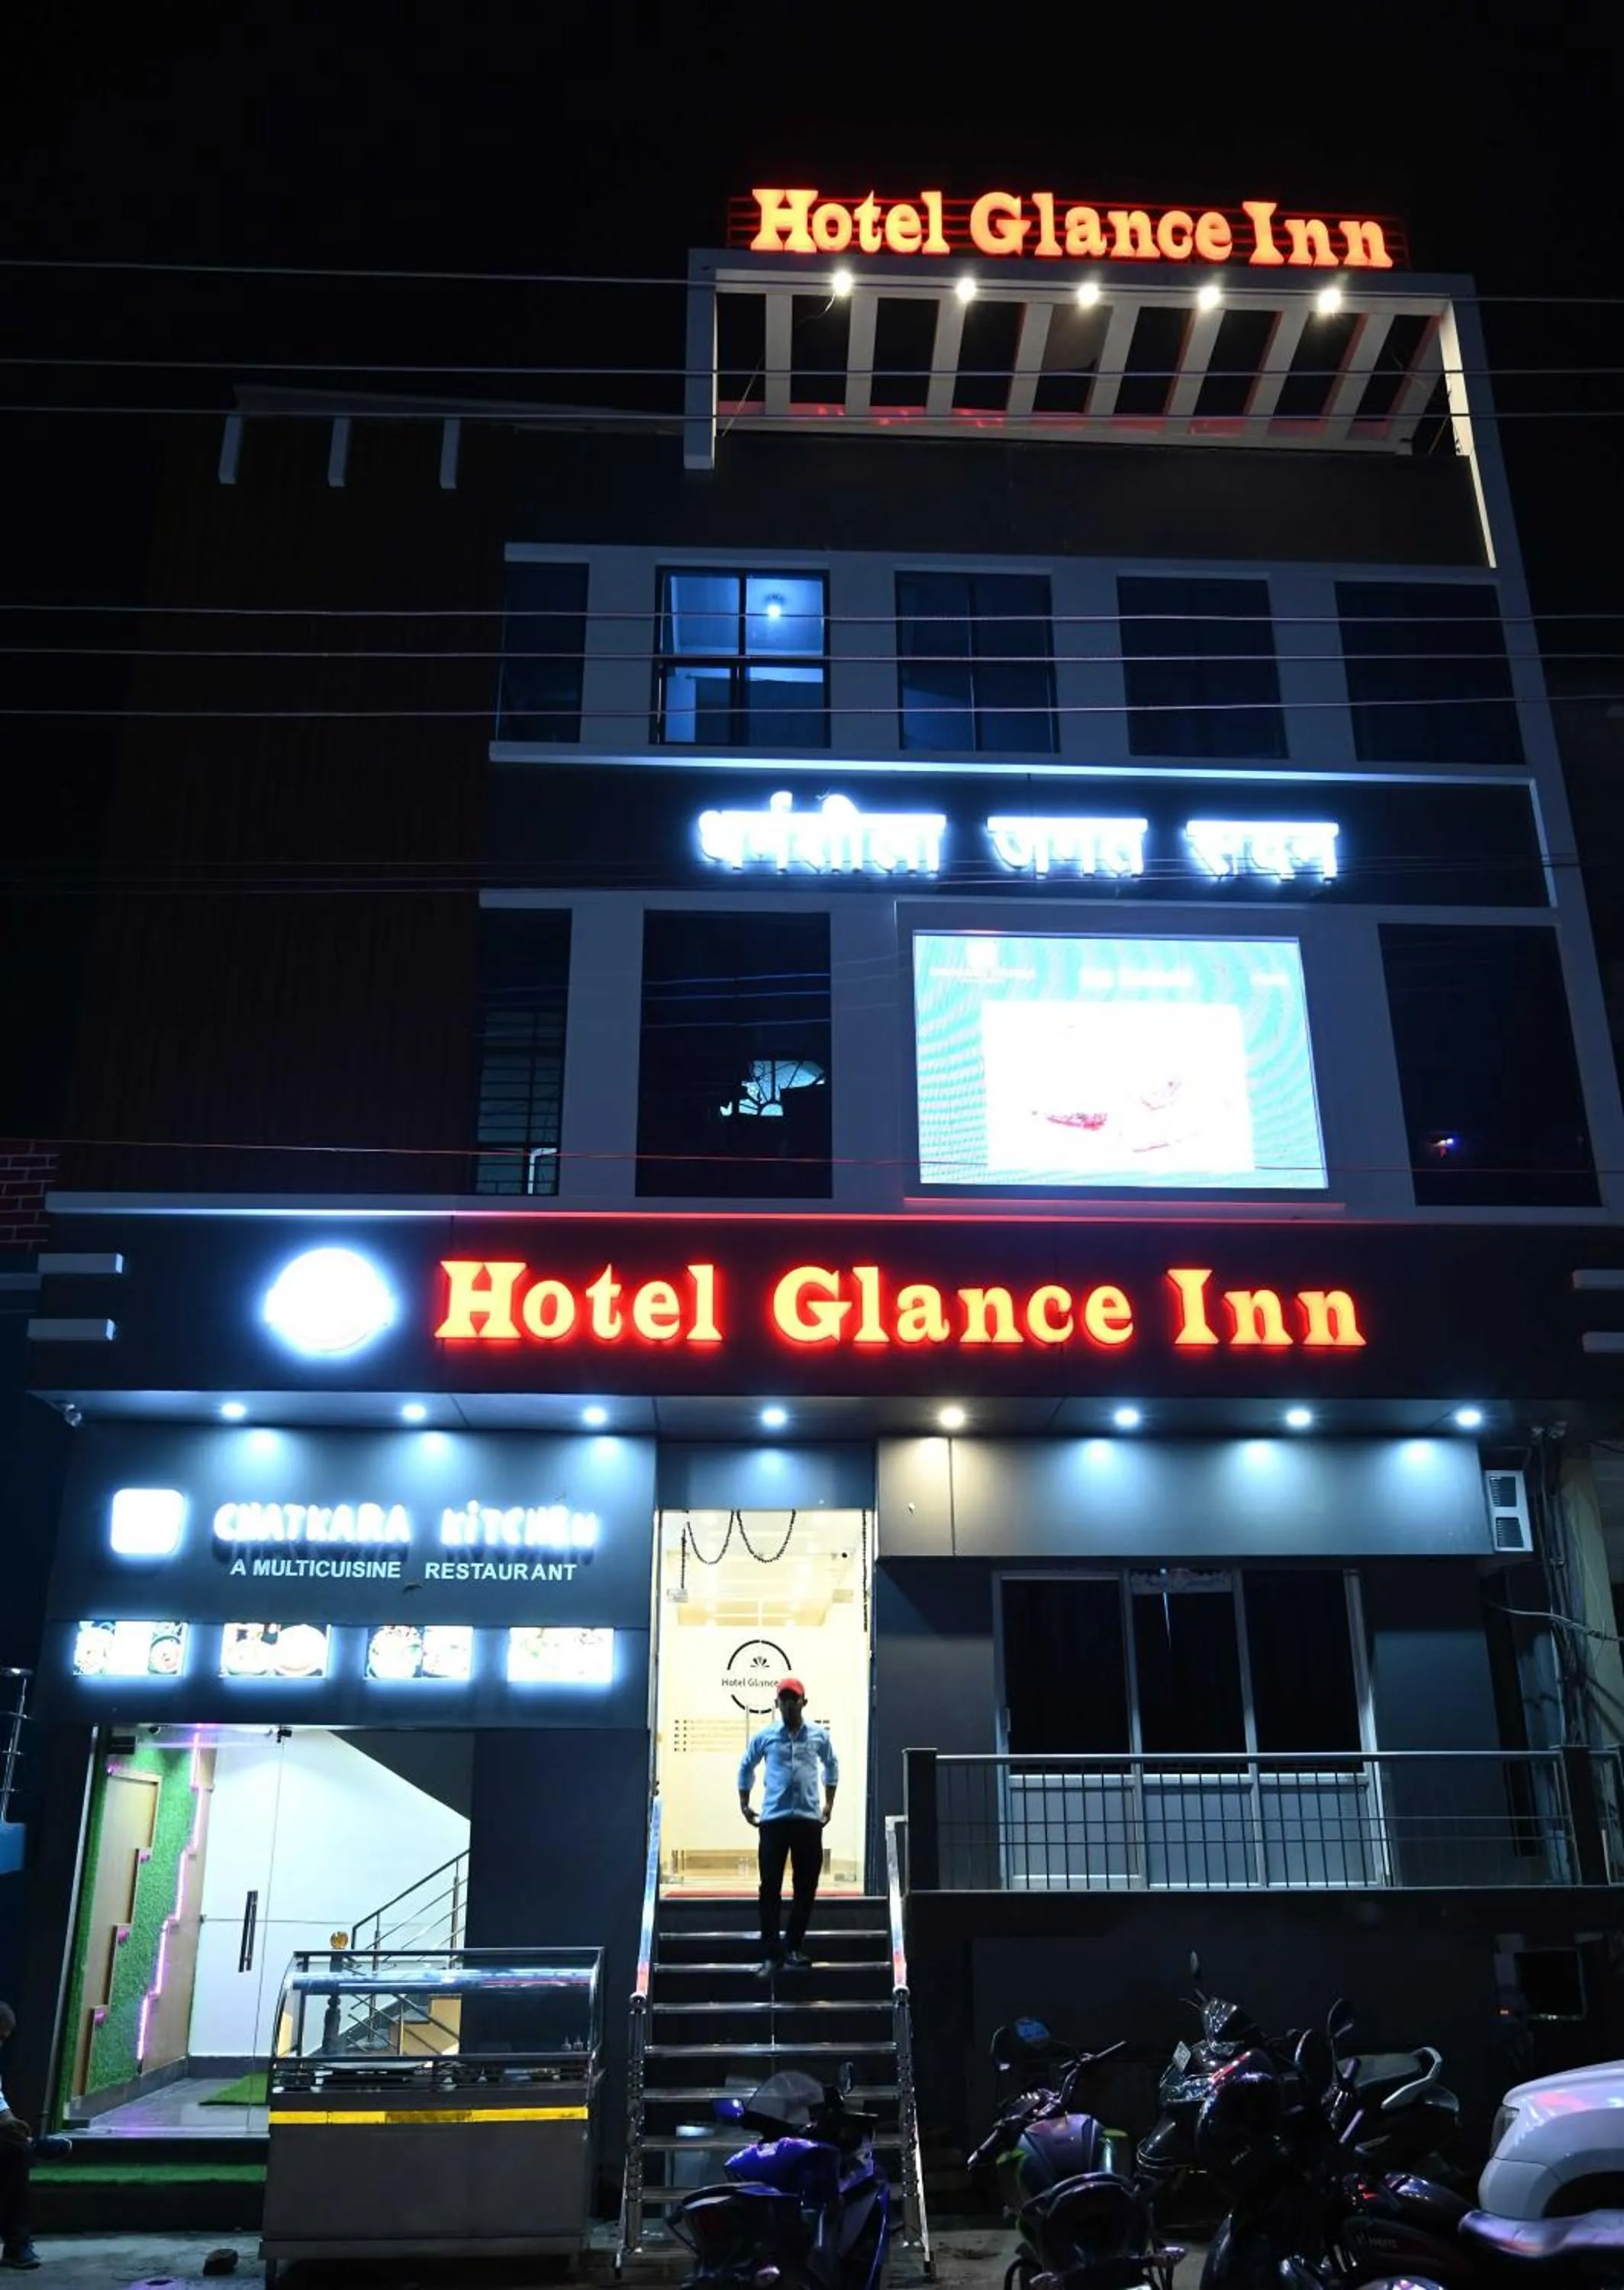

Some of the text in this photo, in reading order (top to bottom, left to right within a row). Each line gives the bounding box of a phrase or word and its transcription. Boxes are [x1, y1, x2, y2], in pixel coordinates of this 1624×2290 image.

[750, 189, 1394, 267] Hotel Glance Inn
[434, 1260, 1367, 1347] Hotel Glance Inn
[214, 1501, 413, 1544] CHATKARA
[230, 1559, 577, 1581] A MULTICUISINE RESTAURANT
[721, 1678, 746, 1687] Hotel
